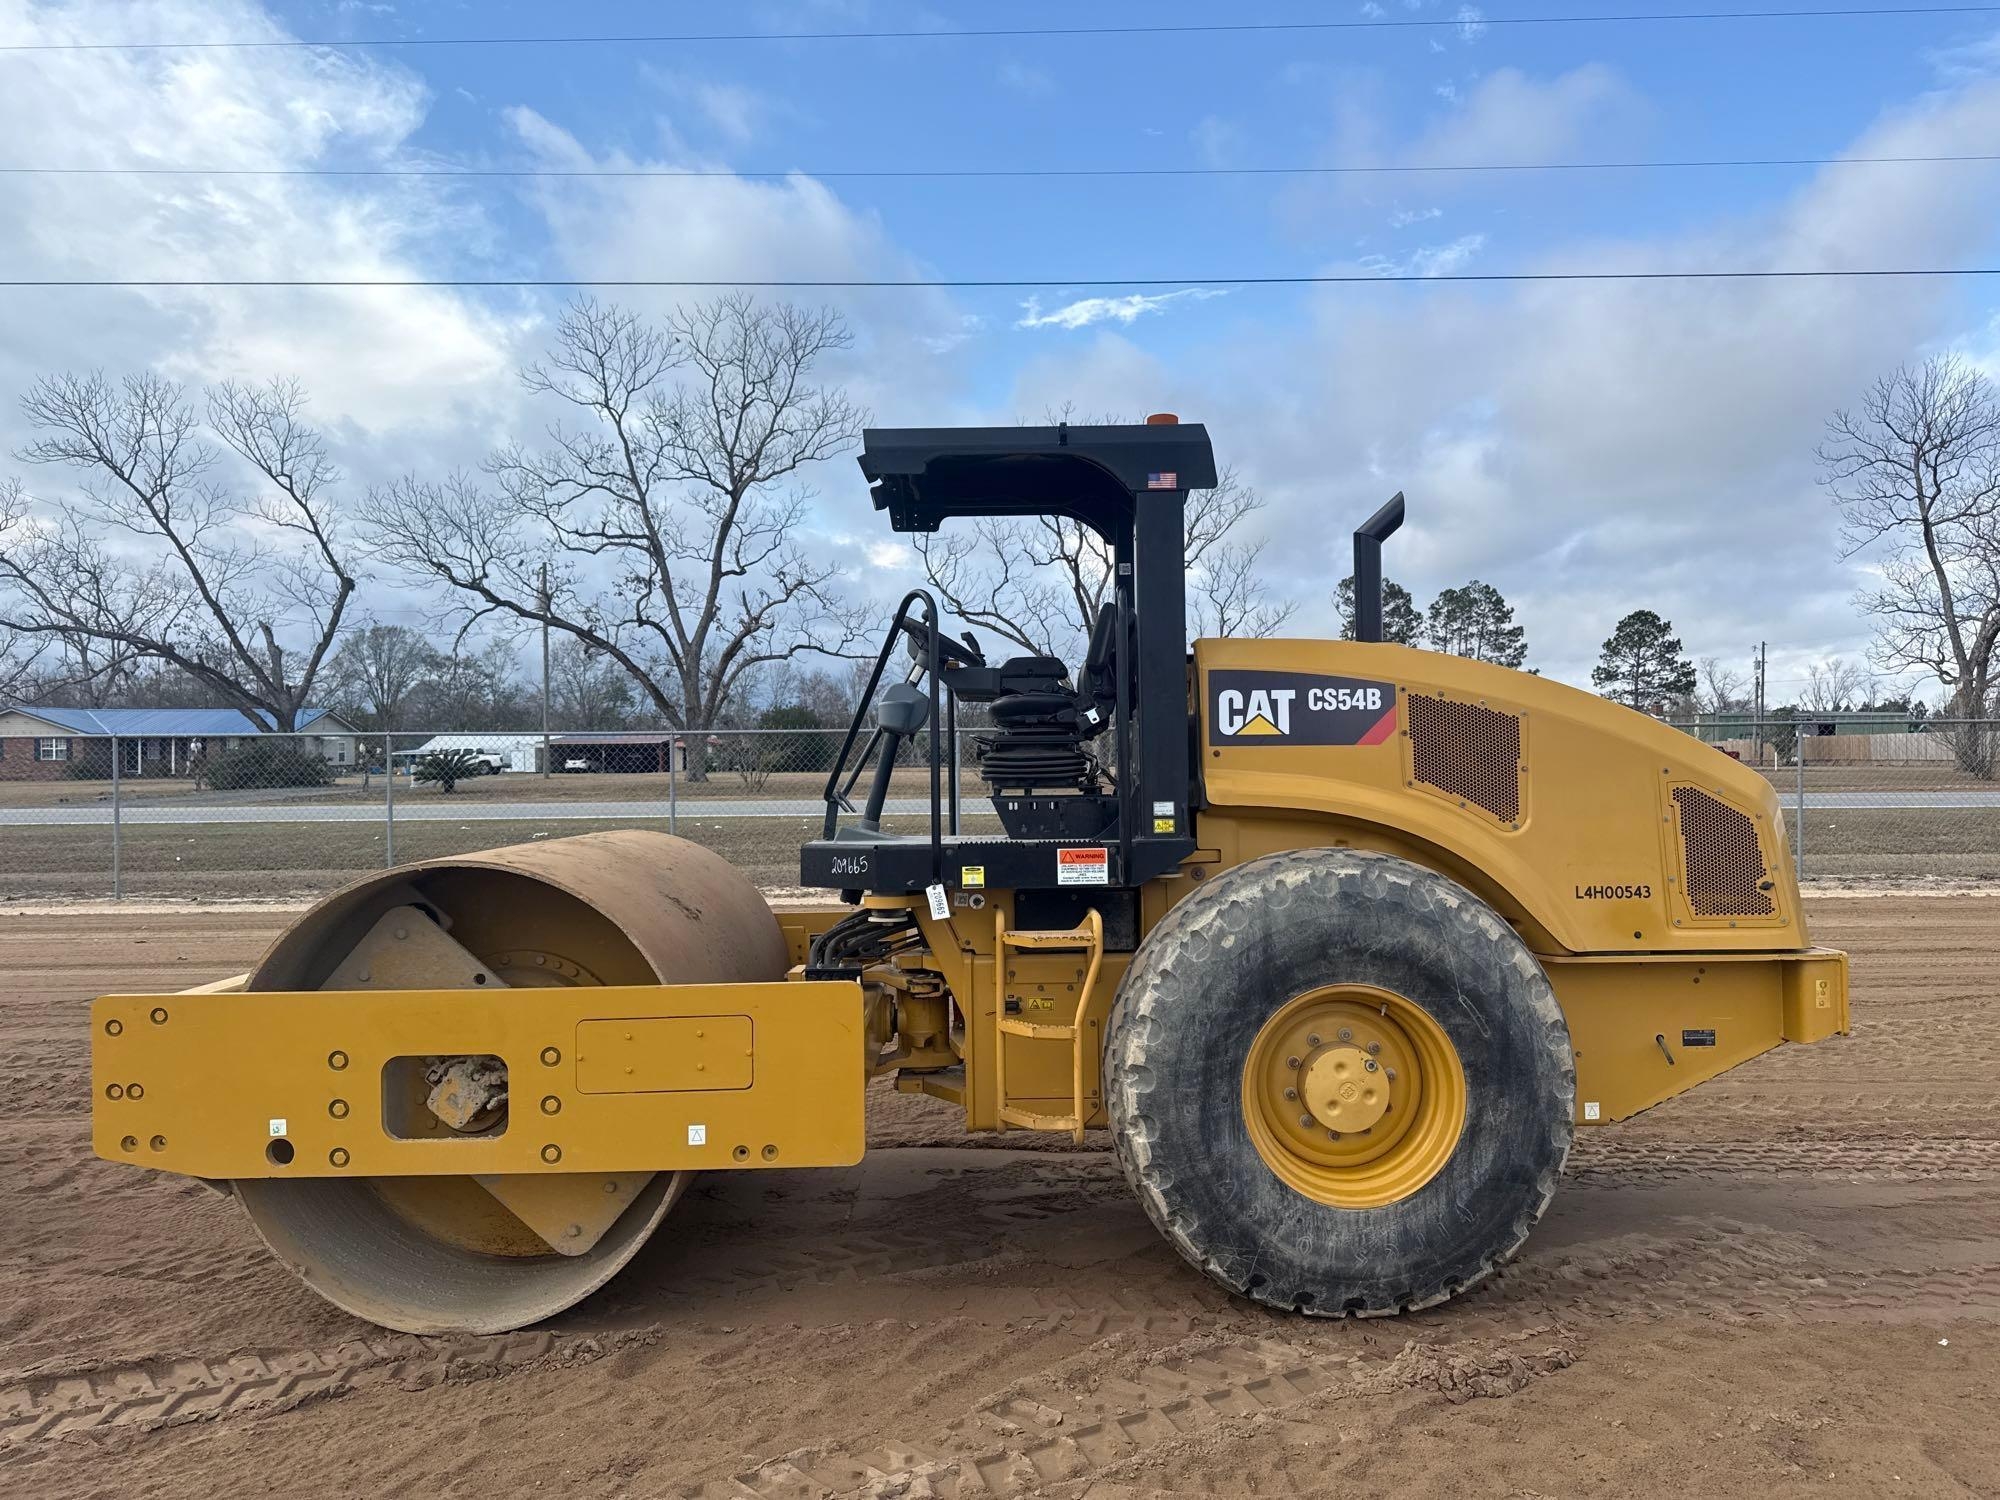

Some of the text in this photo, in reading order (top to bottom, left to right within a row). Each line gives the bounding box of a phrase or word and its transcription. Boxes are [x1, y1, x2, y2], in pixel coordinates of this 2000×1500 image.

[1308, 688, 1382, 711] CS54B
[1218, 689, 1296, 736] CAT
[831, 855, 868, 874] 209665
[1575, 885, 1651, 899] L4H00543
